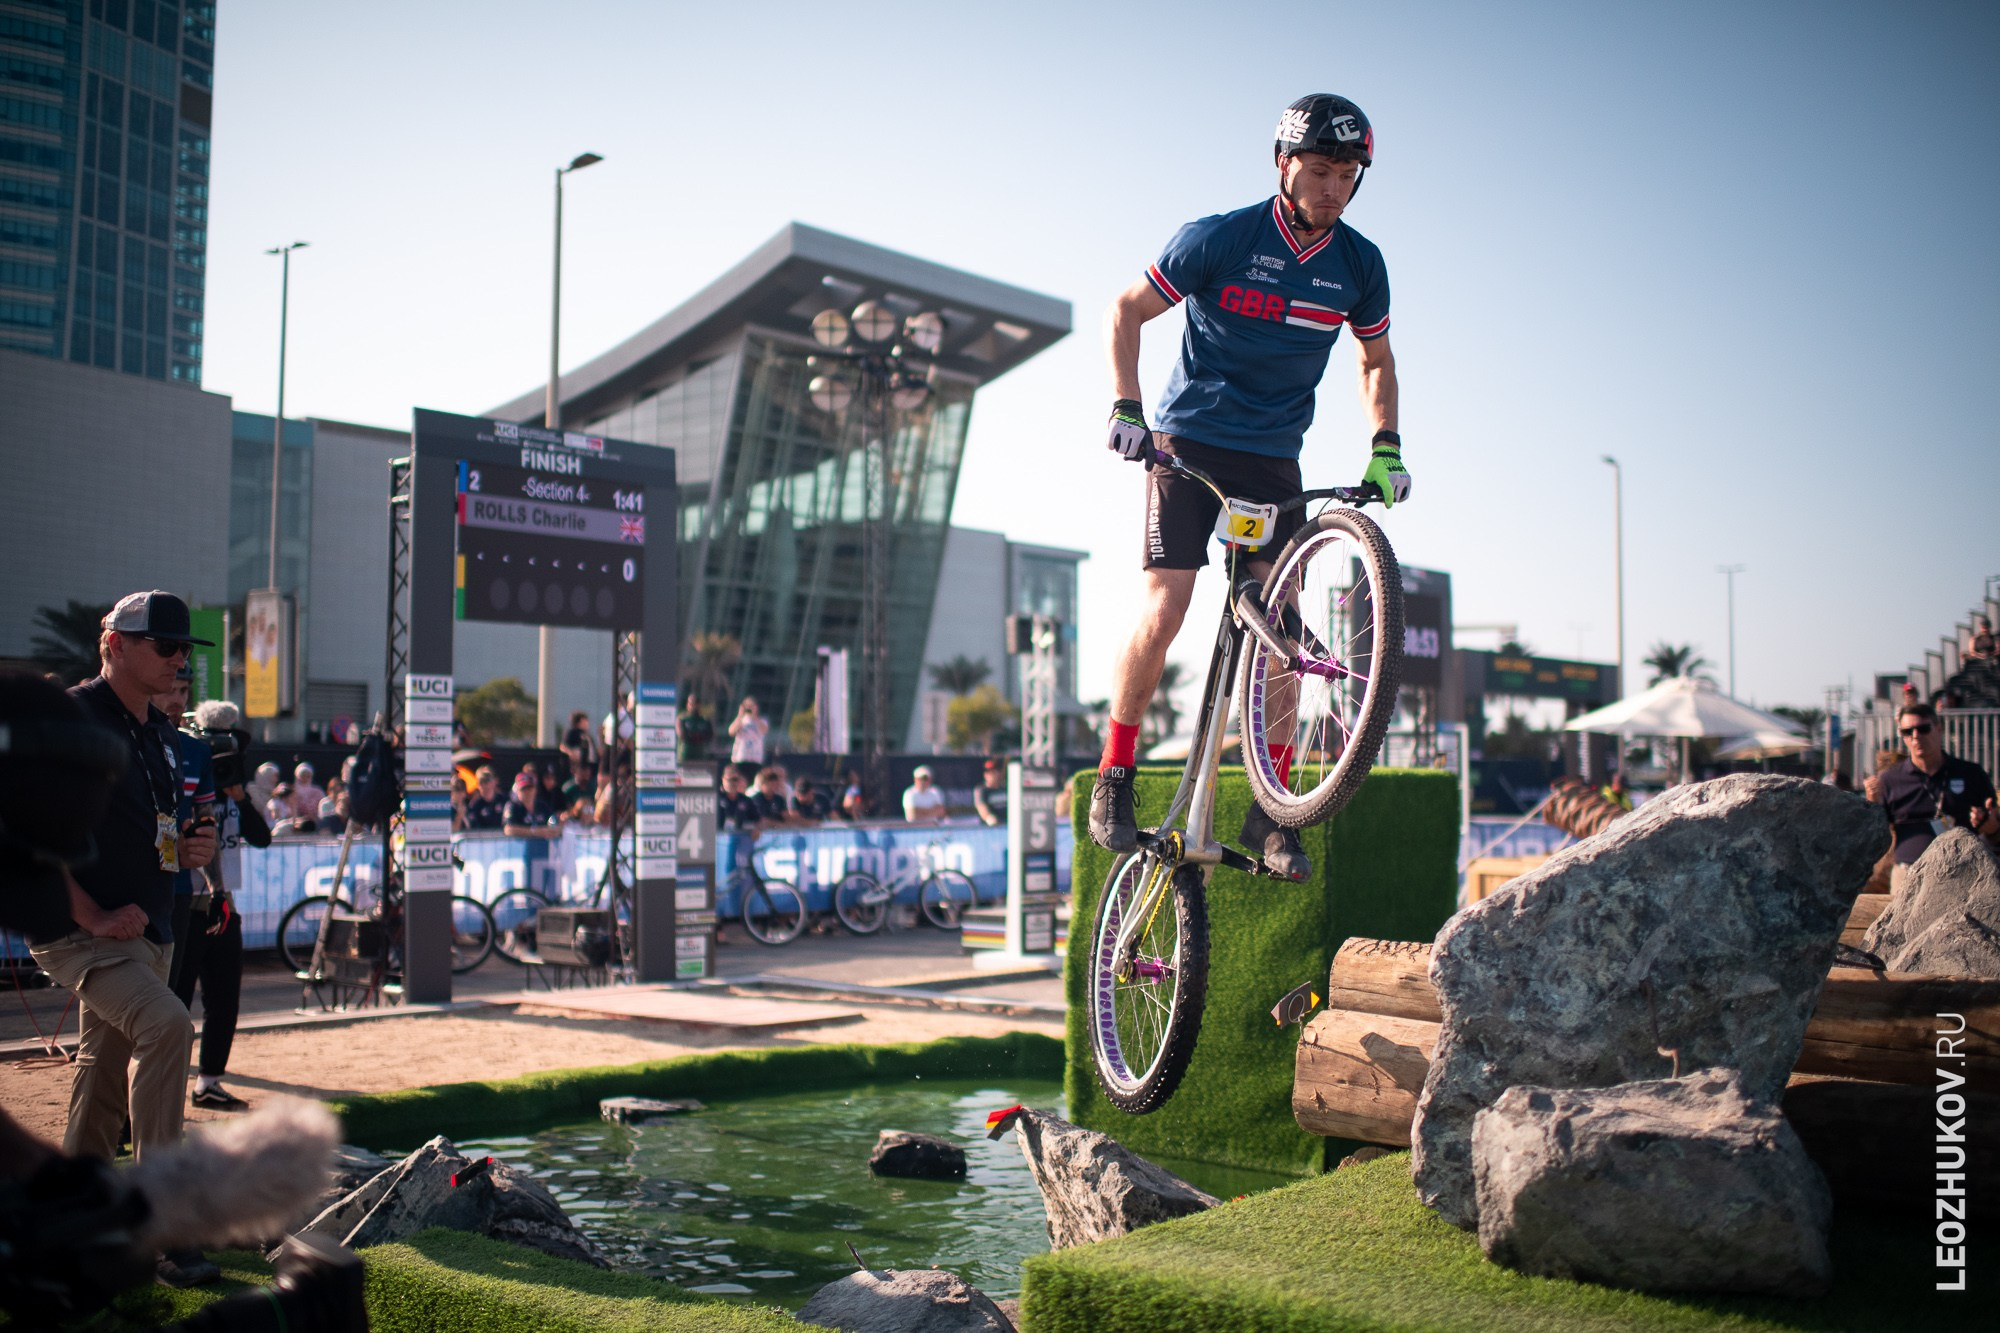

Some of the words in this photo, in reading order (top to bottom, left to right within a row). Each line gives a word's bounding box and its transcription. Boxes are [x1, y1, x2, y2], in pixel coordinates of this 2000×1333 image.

[1279, 108, 1311, 129] RIAL
[1259, 261, 1284, 271] CYCLING
[1260, 255, 1285, 265] BRITISH
[1218, 285, 1285, 322] GBR
[521, 449, 582, 475] FINISH
[469, 470, 480, 491] 2
[612, 489, 643, 512] 1:41
[474, 501, 527, 524] ROLLS
[532, 508, 586, 531] Charlie
[1243, 519, 1257, 537] 2
[622, 558, 635, 582] 0
[418, 679, 449, 694] UCI
[675, 795, 714, 814] INISH
[678, 816, 704, 859] 4
[1030, 811, 1048, 849] 5
[418, 848, 447, 862] UCI
